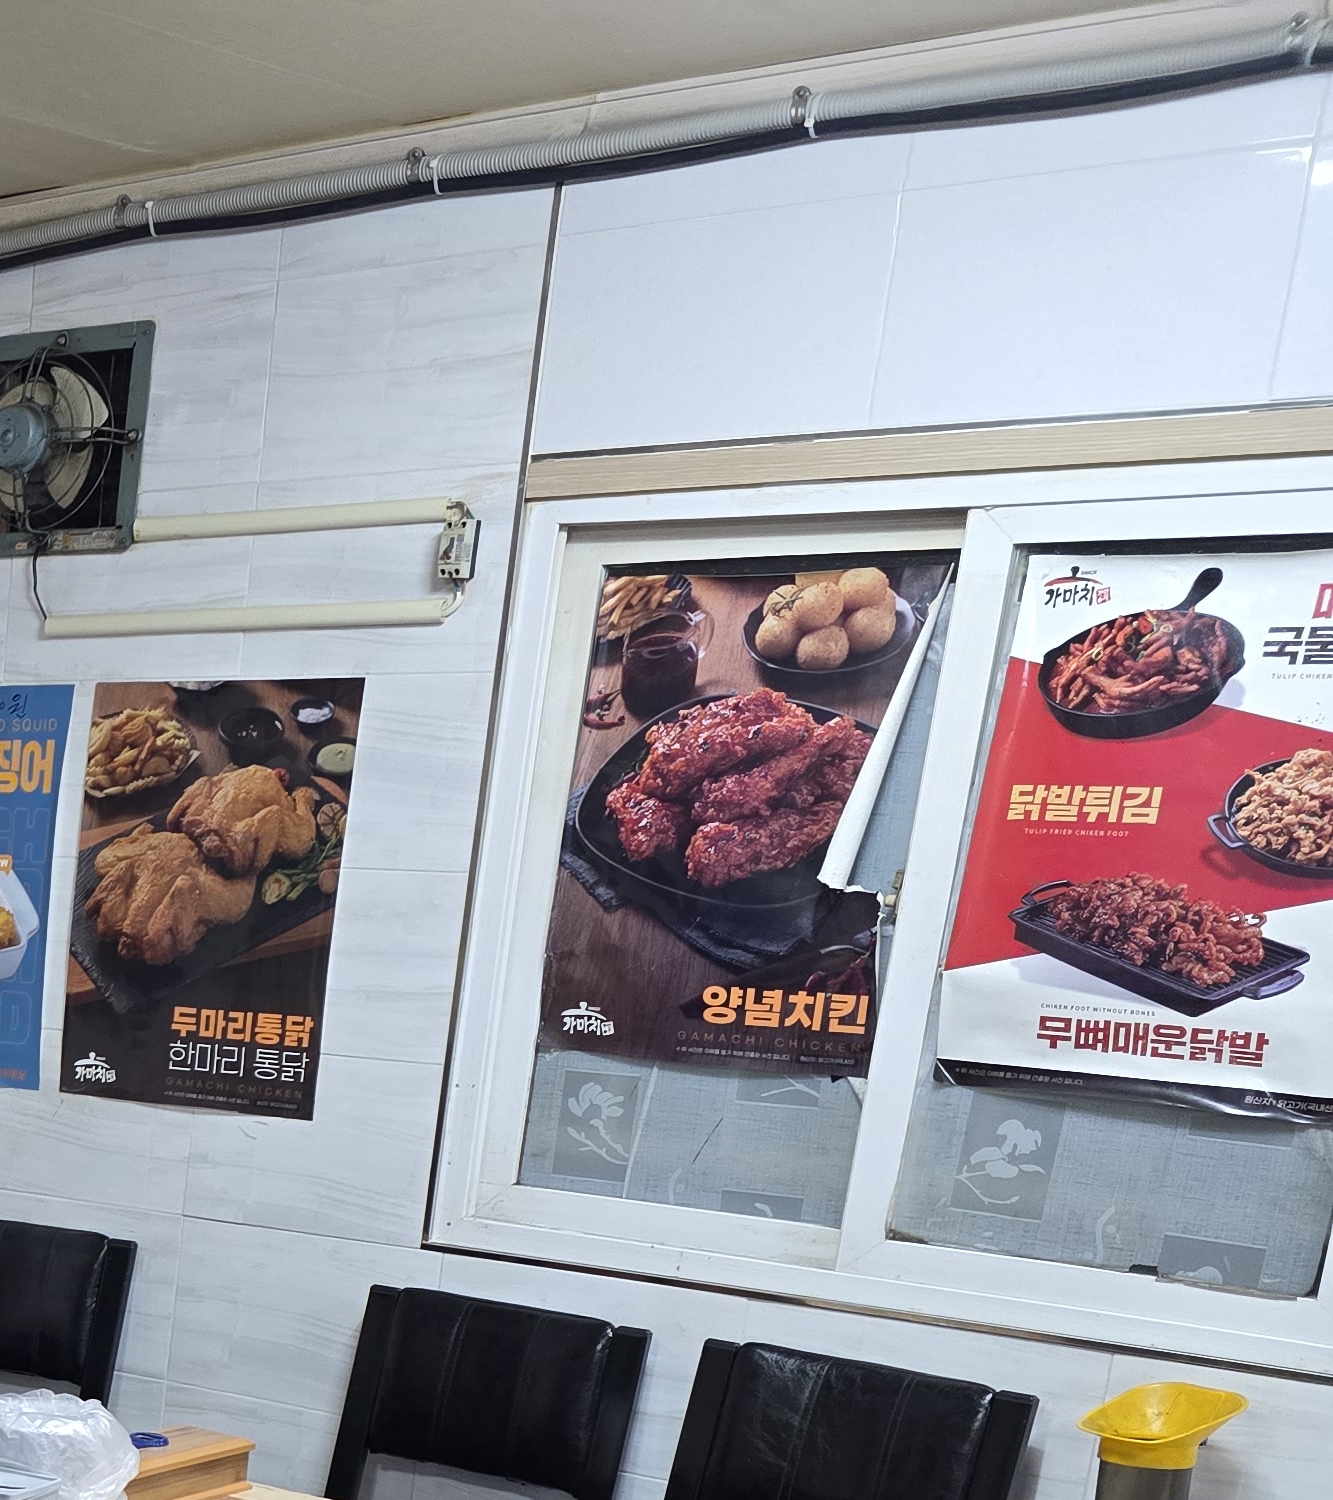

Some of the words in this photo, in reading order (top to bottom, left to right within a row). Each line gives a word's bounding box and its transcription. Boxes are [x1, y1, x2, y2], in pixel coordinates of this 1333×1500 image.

[1045, 586, 1095, 608] 가마치
[12, 717, 58, 732] SQUID
[1007, 785, 1163, 824] 닭발튀김
[702, 985, 869, 1034] 양념치킨
[1041, 1002, 1068, 1011] CHIKEN
[1070, 1004, 1090, 1012] FOOT
[1093, 1006, 1127, 1014] WITHOUT
[1130, 1009, 1156, 1017] BONES
[171, 1005, 314, 1047] 두마리통닭
[562, 1017, 602, 1034] 가마치
[677, 1030, 763, 1046] GAMACHI
[774, 1037, 862, 1052] CHICKEN
[1037, 1015, 1269, 1067] 무뼈매운닭발
[168, 1040, 246, 1077] 한마리
[253, 1048, 310, 1082] 통닭
[74, 1065, 106, 1083] 가마치
[165, 1077, 230, 1091] GAMACHI
[238, 1083, 303, 1099] CHICKEN
